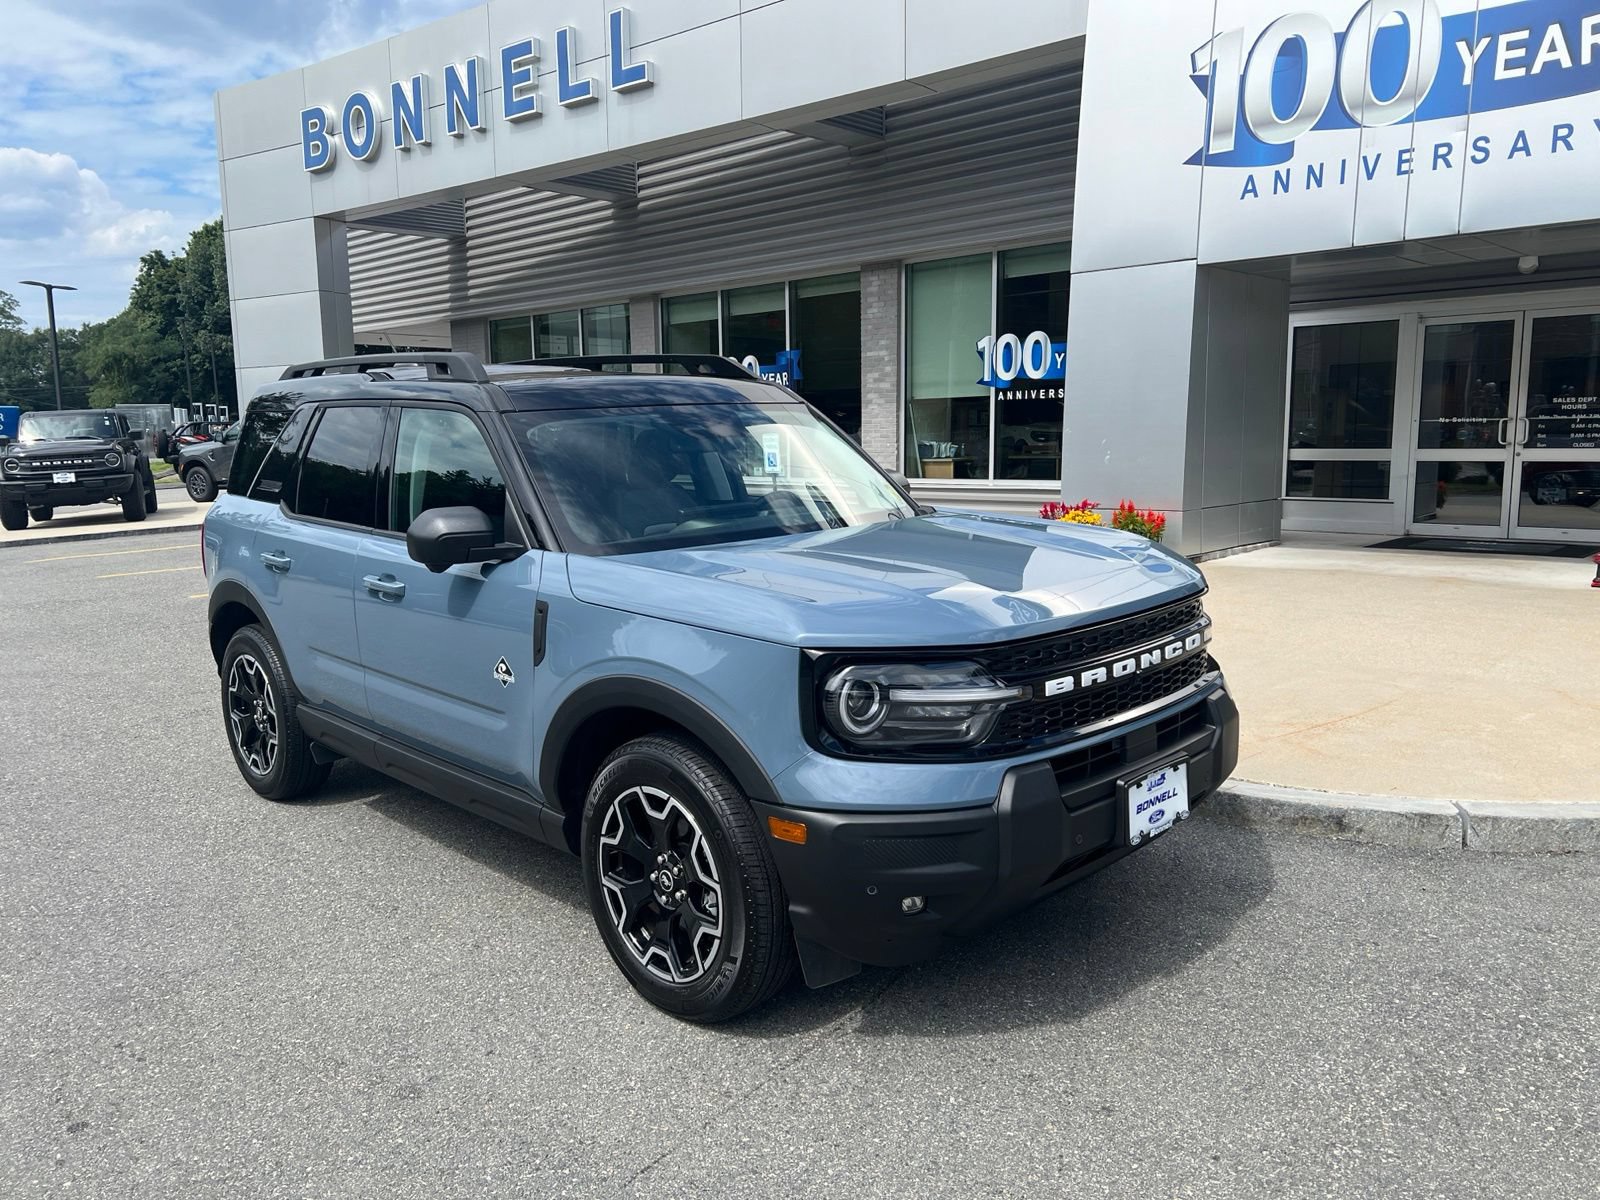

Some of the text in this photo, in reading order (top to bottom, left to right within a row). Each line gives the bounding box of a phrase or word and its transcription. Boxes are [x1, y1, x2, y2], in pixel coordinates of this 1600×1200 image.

[300, 8, 652, 172] BONNELL
[1190, 0, 1442, 155] 100
[762, 371, 789, 386] YEAR
[977, 330, 1052, 382] 100
[1045, 632, 1201, 697] BRONCO
[1136, 786, 1179, 815] BONNELL
